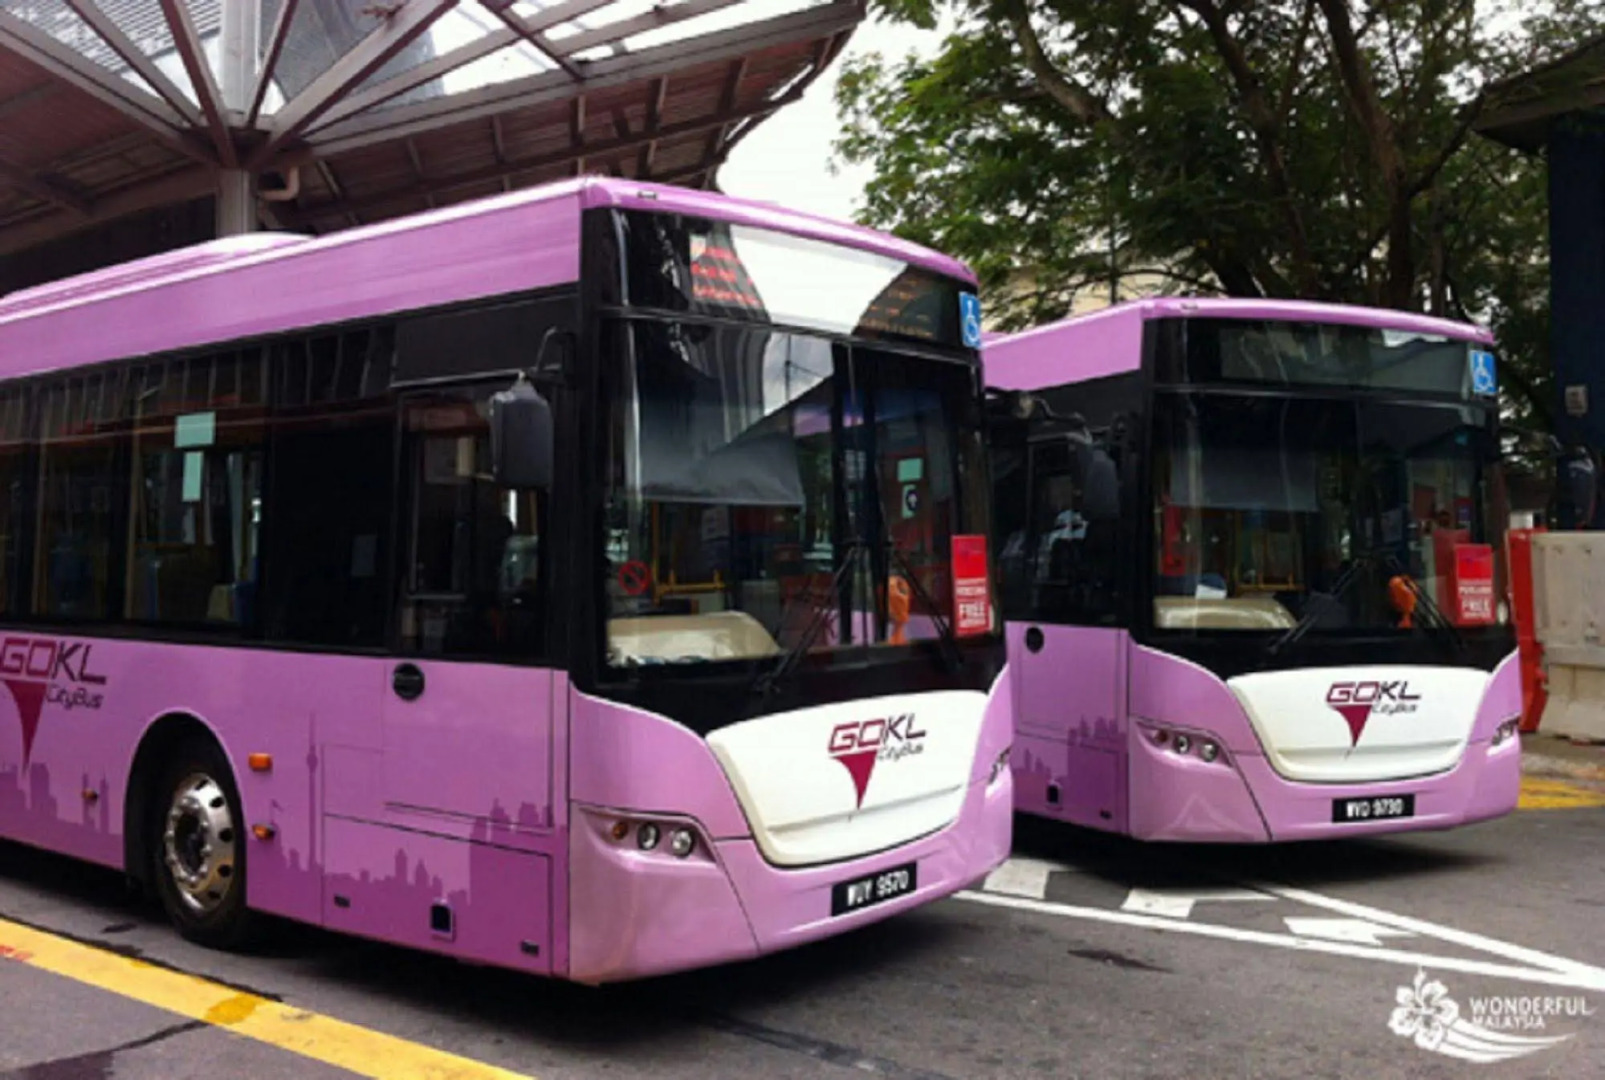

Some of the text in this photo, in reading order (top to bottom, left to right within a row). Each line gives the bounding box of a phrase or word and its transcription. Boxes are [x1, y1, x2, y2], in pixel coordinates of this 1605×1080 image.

[0, 637, 106, 684] GOKL
[47, 683, 103, 709] CityBus
[1326, 681, 1421, 702] GOKL
[828, 713, 926, 752] GOKL
